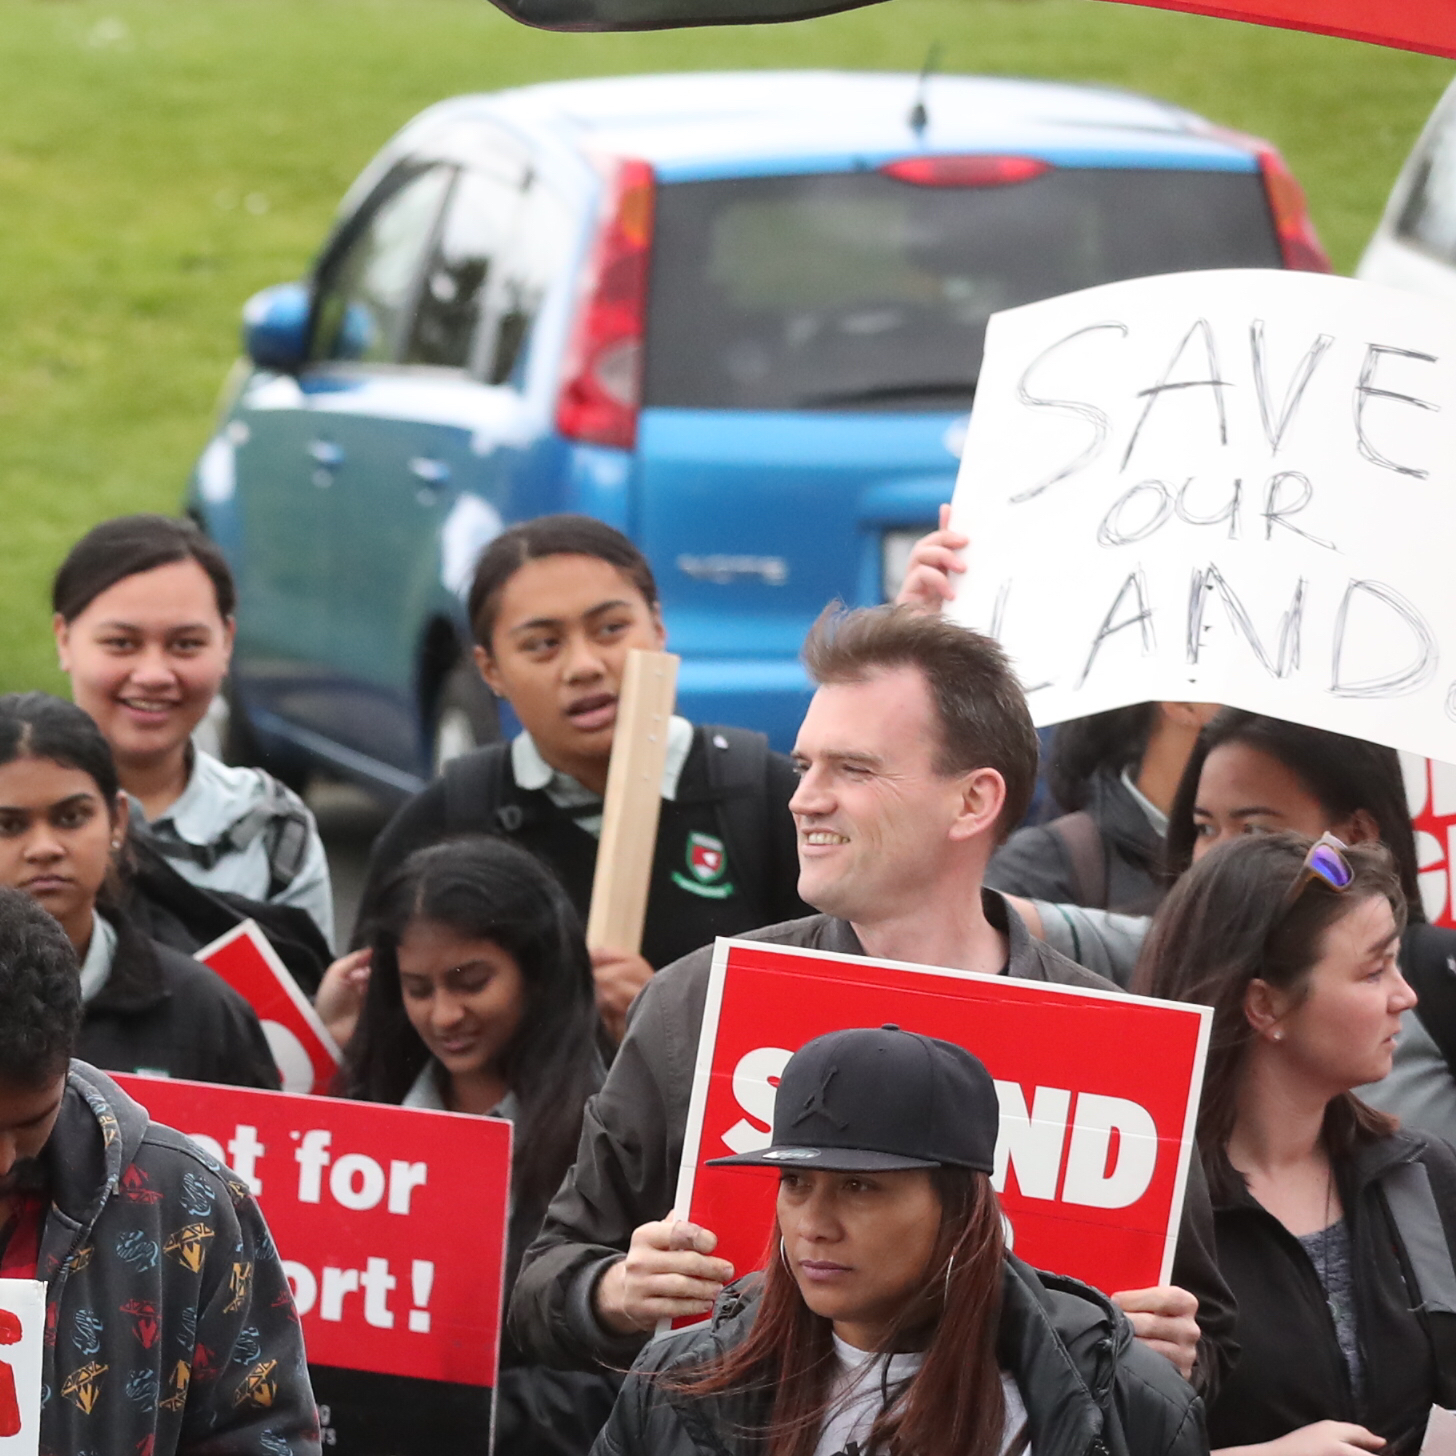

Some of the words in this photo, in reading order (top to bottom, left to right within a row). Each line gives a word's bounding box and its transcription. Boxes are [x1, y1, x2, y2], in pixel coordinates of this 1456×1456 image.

[1009, 318, 1441, 505] SAVE
[1097, 471, 1345, 554] OUR
[721, 1047, 1158, 1209] SND
[295, 1130, 427, 1215] for
[283, 1257, 435, 1333] ort!
